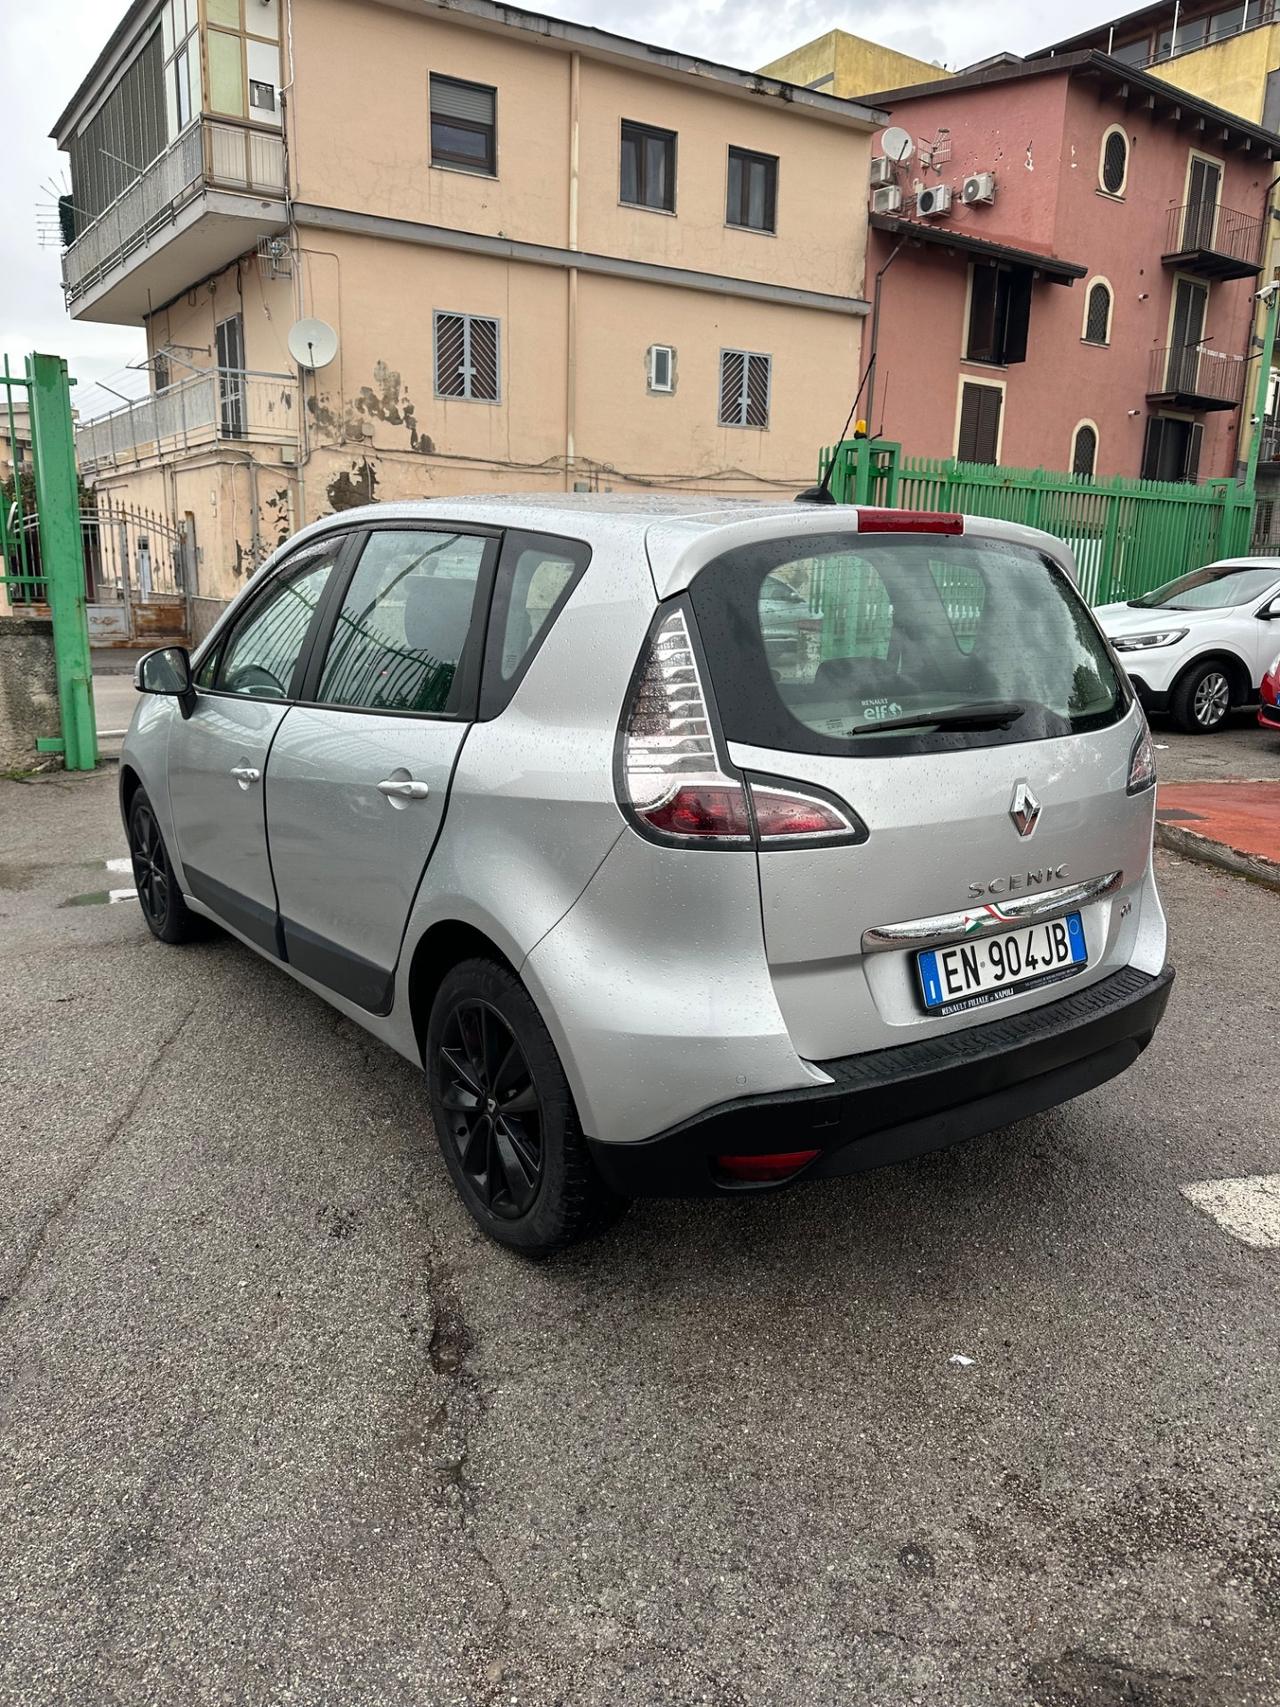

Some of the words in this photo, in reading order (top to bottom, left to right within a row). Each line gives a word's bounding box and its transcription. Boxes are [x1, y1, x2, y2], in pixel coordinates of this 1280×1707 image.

[864, 705, 888, 720] elf
[968, 863, 1070, 898] SCENIC
[941, 945, 981, 995] EN
[988, 923, 1069, 981] 904JB
[942, 1002, 967, 1015] RENAULT
[968, 995, 989, 1008] FILIALE
[994, 987, 1014, 1000] NAPOLI
